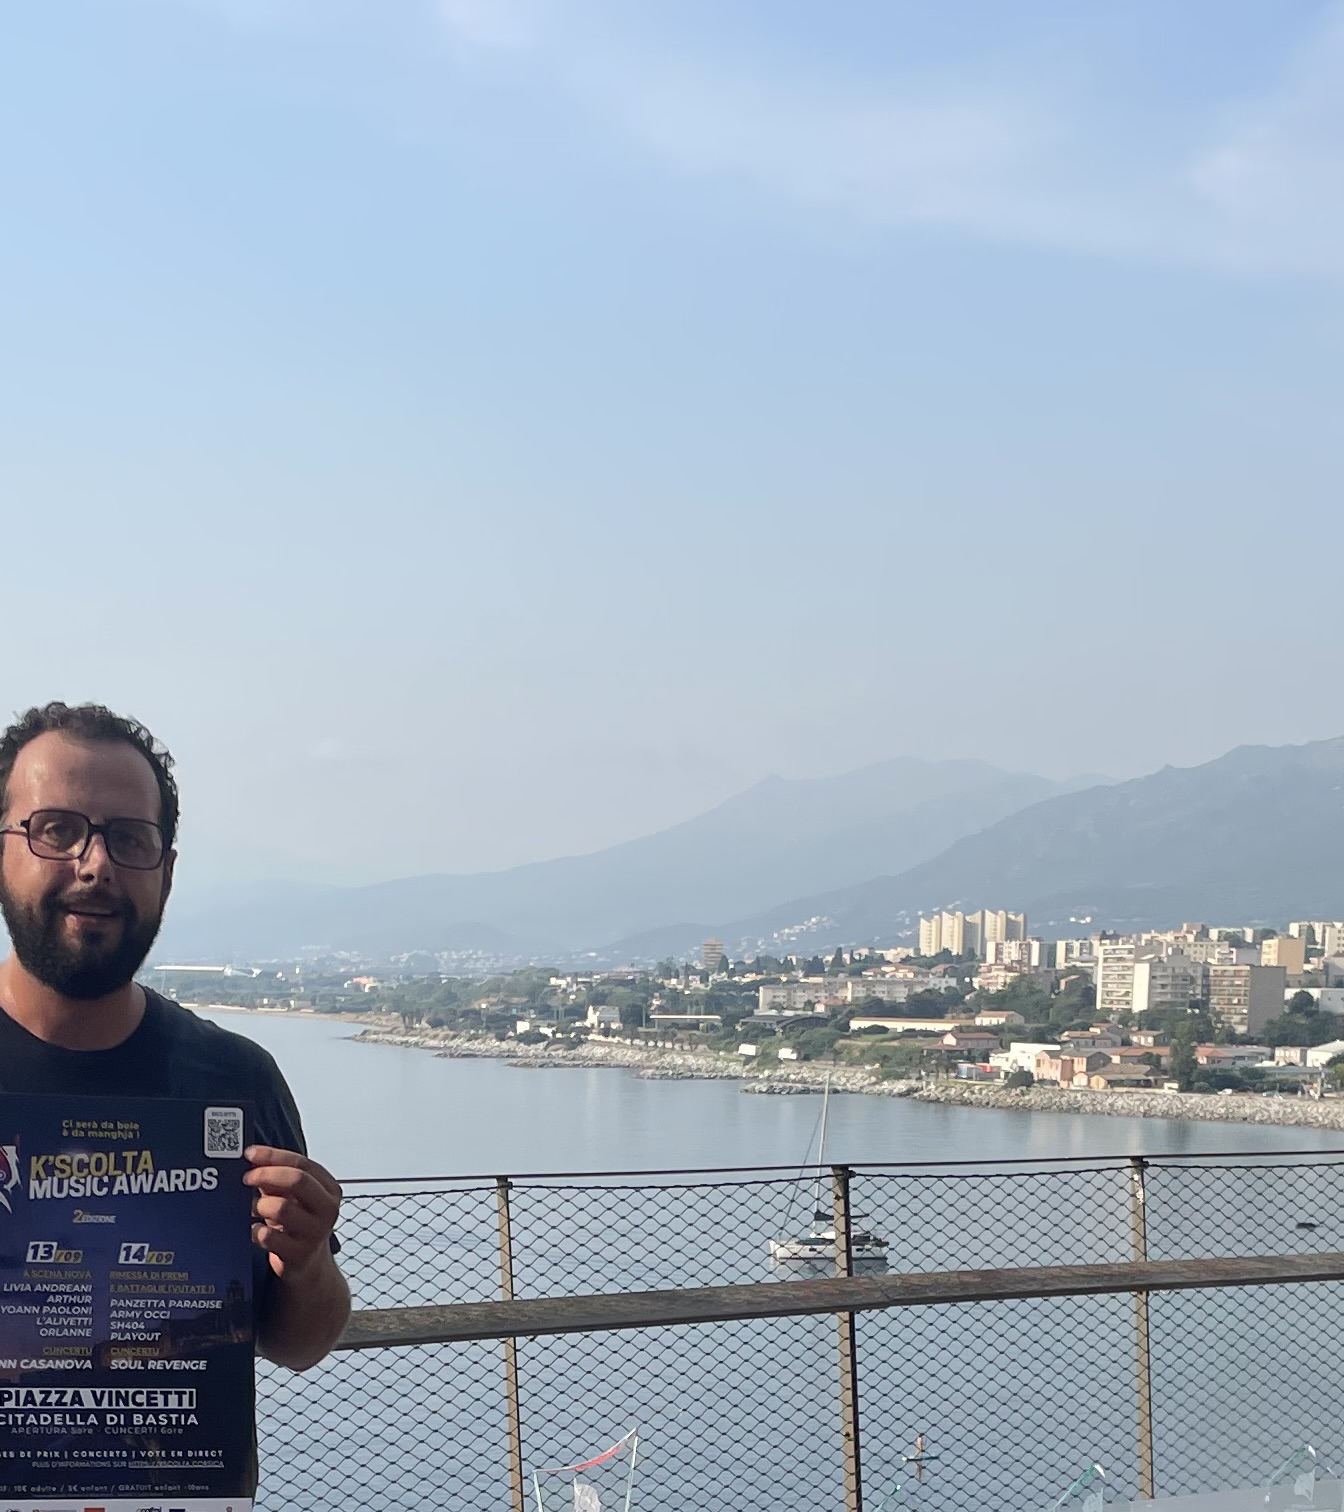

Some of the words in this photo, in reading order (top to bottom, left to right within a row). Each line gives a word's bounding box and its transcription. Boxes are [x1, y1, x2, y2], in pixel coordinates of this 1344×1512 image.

[30, 1150, 154, 1180] K'SCOLTA
[29, 1173, 109, 1200] MUSIC
[112, 1167, 218, 1196] AWARDS
[3, 1284, 32, 1292] LIVIA
[34, 1284, 92, 1292] ANDREANI
[46, 1295, 92, 1304] ARTHUR
[110, 1299, 166, 1308] PANZETTA
[168, 1300, 222, 1309] PARADISE
[0, 1306, 40, 1314] YOANN
[42, 1306, 92, 1315] PAOLONI
[110, 1310, 143, 1319] ARMY
[144, 1311, 170, 1319] OCCI
[39, 1328, 92, 1337] ORLANNE
[110, 1332, 161, 1341] PLAYOUT
[19, 1359, 93, 1370] CASANOVA
[110, 1360, 145, 1370] SOUL
[147, 1360, 207, 1371] REVENGE
[0, 1389, 84, 1407] PIAZZA
[90, 1390, 194, 1407] VINCETTI
[106, 1413, 125, 1425] DI
[132, 1413, 198, 1426] BASTIA
[188, 1450, 224, 1458] DIRECT
